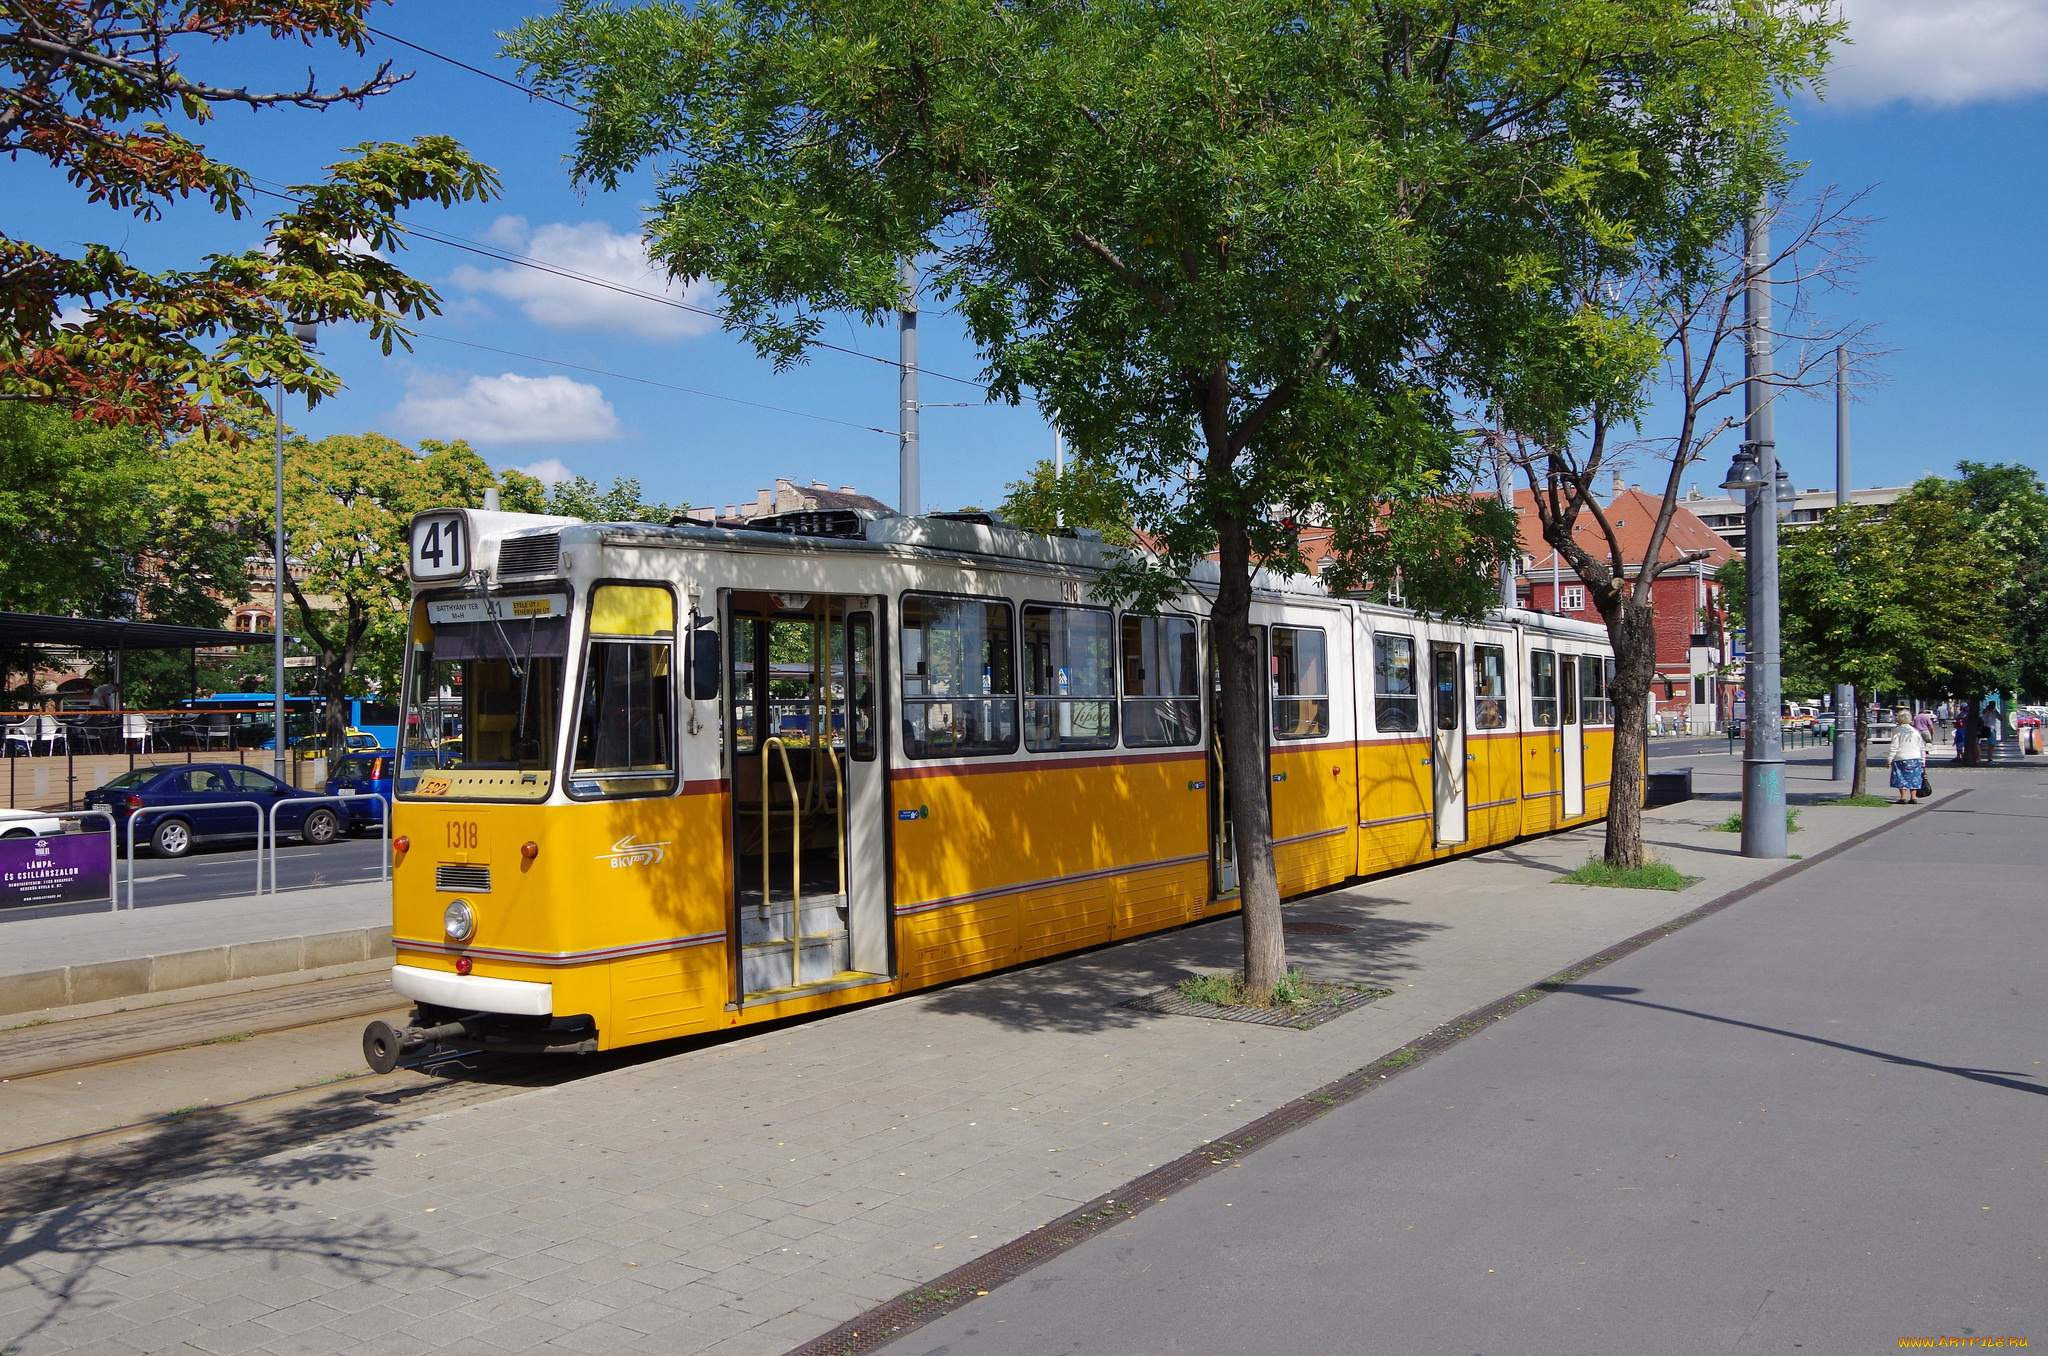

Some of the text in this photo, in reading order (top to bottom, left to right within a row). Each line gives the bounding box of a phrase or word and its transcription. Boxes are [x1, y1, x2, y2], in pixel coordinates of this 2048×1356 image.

[421, 519, 459, 568] 41
[1060, 580, 1078, 602] 1318
[446, 821, 478, 849] 1318
[26, 860, 56, 870] LÁMPA-
[610, 856, 634, 868] BKV
[4, 867, 79, 881] ÉS CSILLÁRSZALON
